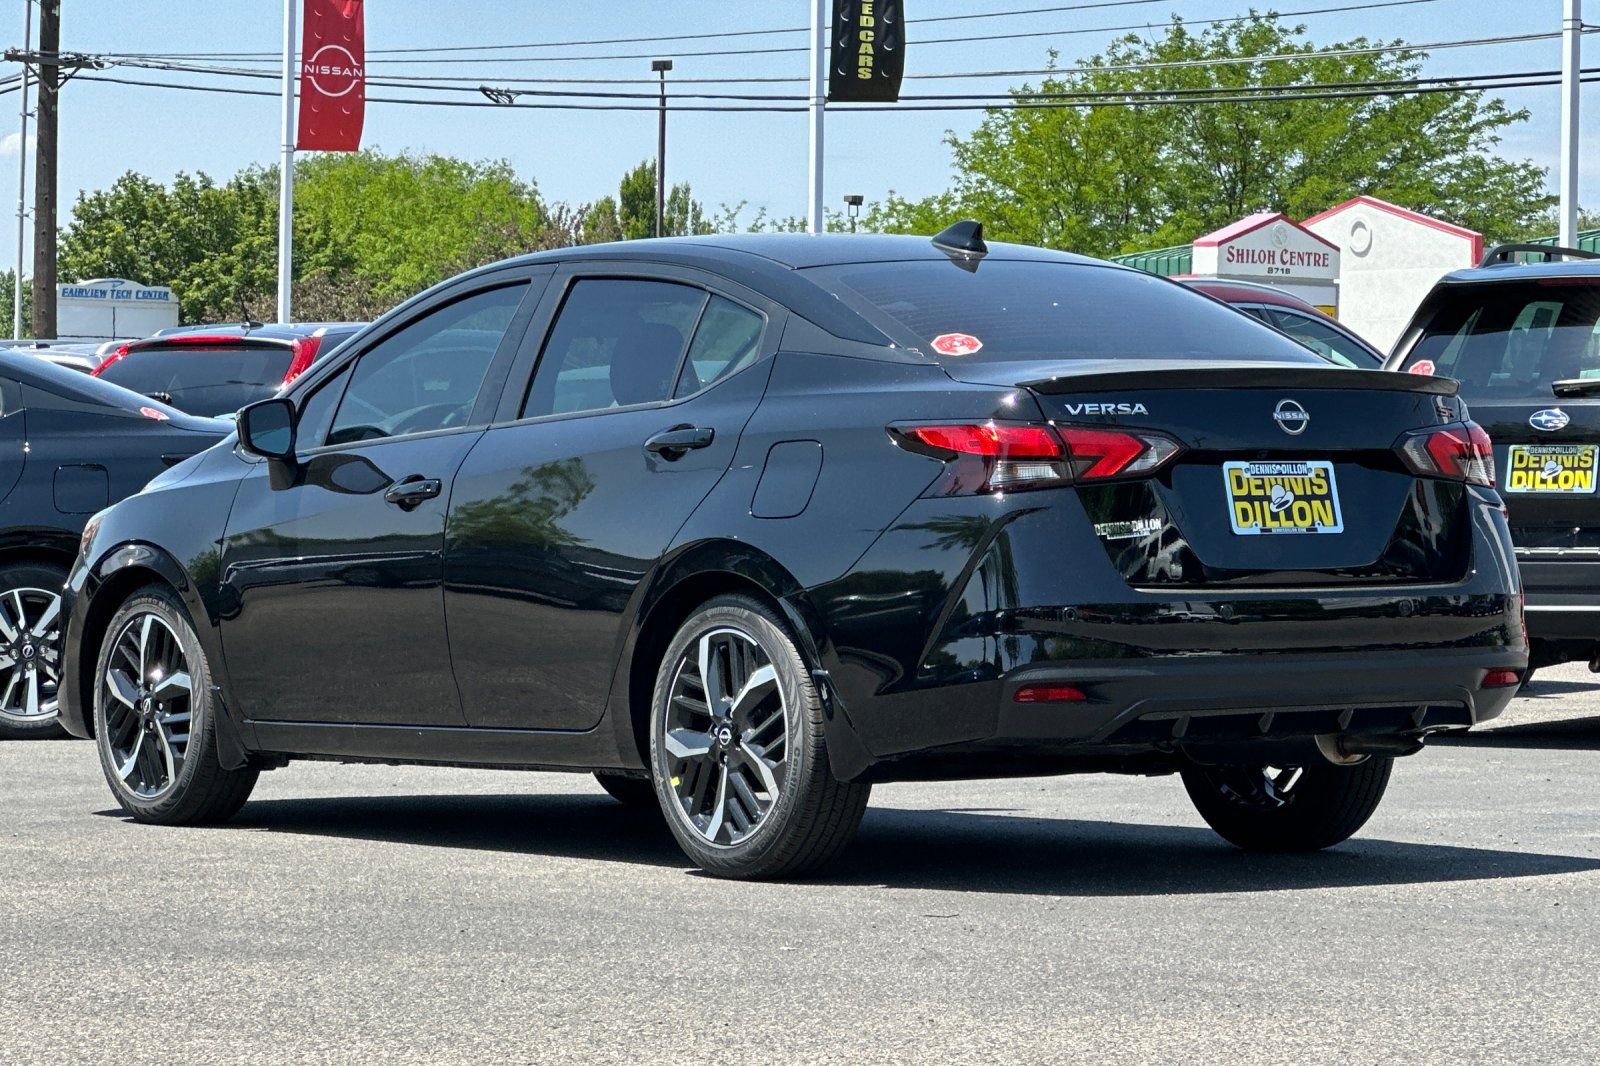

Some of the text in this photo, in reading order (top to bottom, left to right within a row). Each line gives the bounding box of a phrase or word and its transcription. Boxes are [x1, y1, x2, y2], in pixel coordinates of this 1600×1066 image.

[304, 64, 363, 77] NISSAN
[1226, 245, 1329, 267] SHILOH CENTRE
[61, 287, 169, 301] FAIRVIEW TECH CENTER
[1064, 403, 1149, 416] VERSA
[1273, 411, 1310, 421] NISSAN
[1249, 463, 1308, 475] DENNIS DILLON
[1512, 470, 1592, 489] DILLON
[1235, 500, 1334, 528] DILLON
